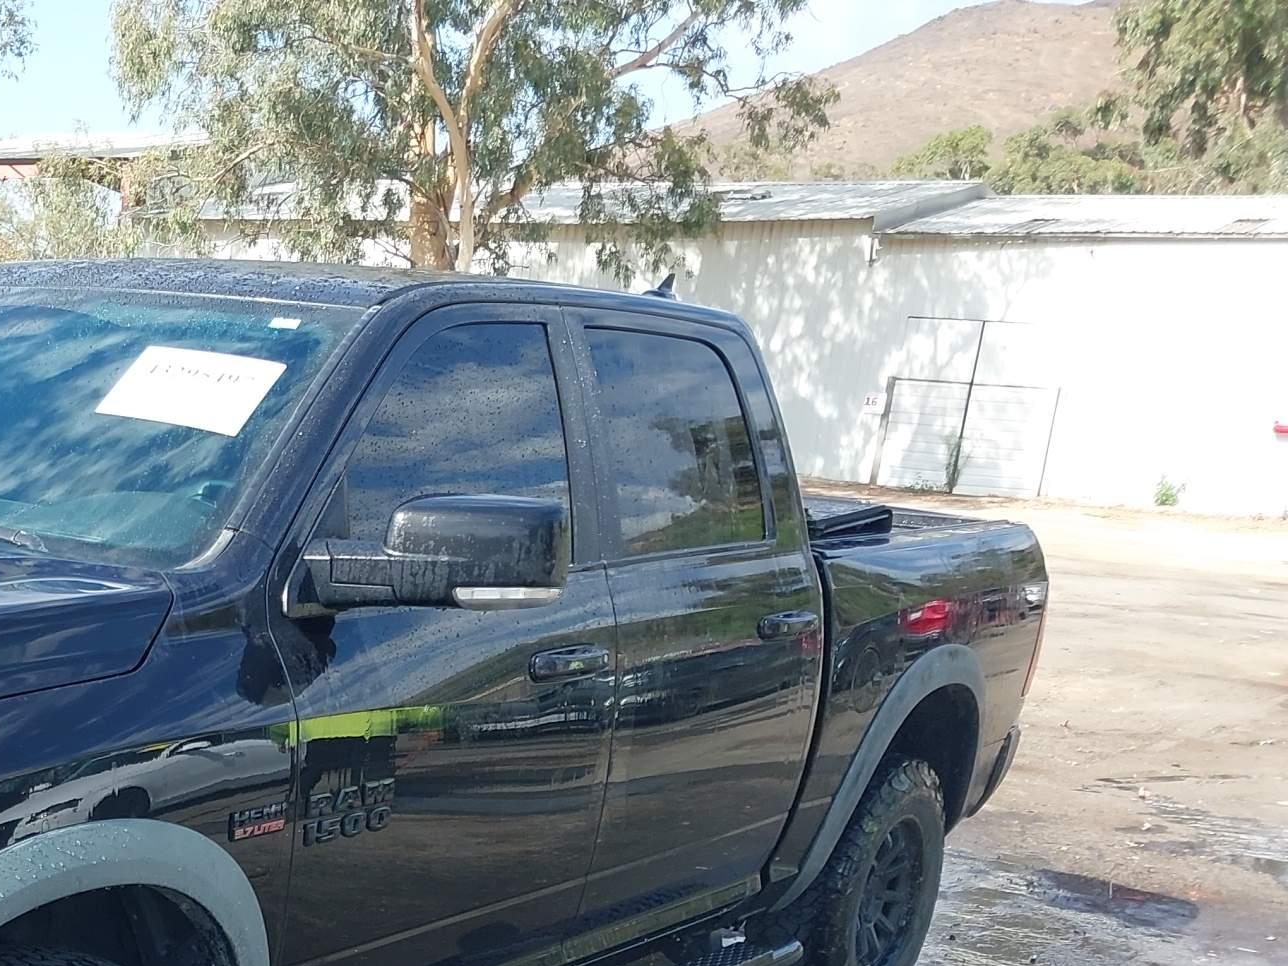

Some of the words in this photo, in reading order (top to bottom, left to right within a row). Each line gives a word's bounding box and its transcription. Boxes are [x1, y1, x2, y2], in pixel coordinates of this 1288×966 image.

[864, 396, 878, 406] 16
[309, 777, 396, 818] RAM
[302, 806, 393, 847] 1500
